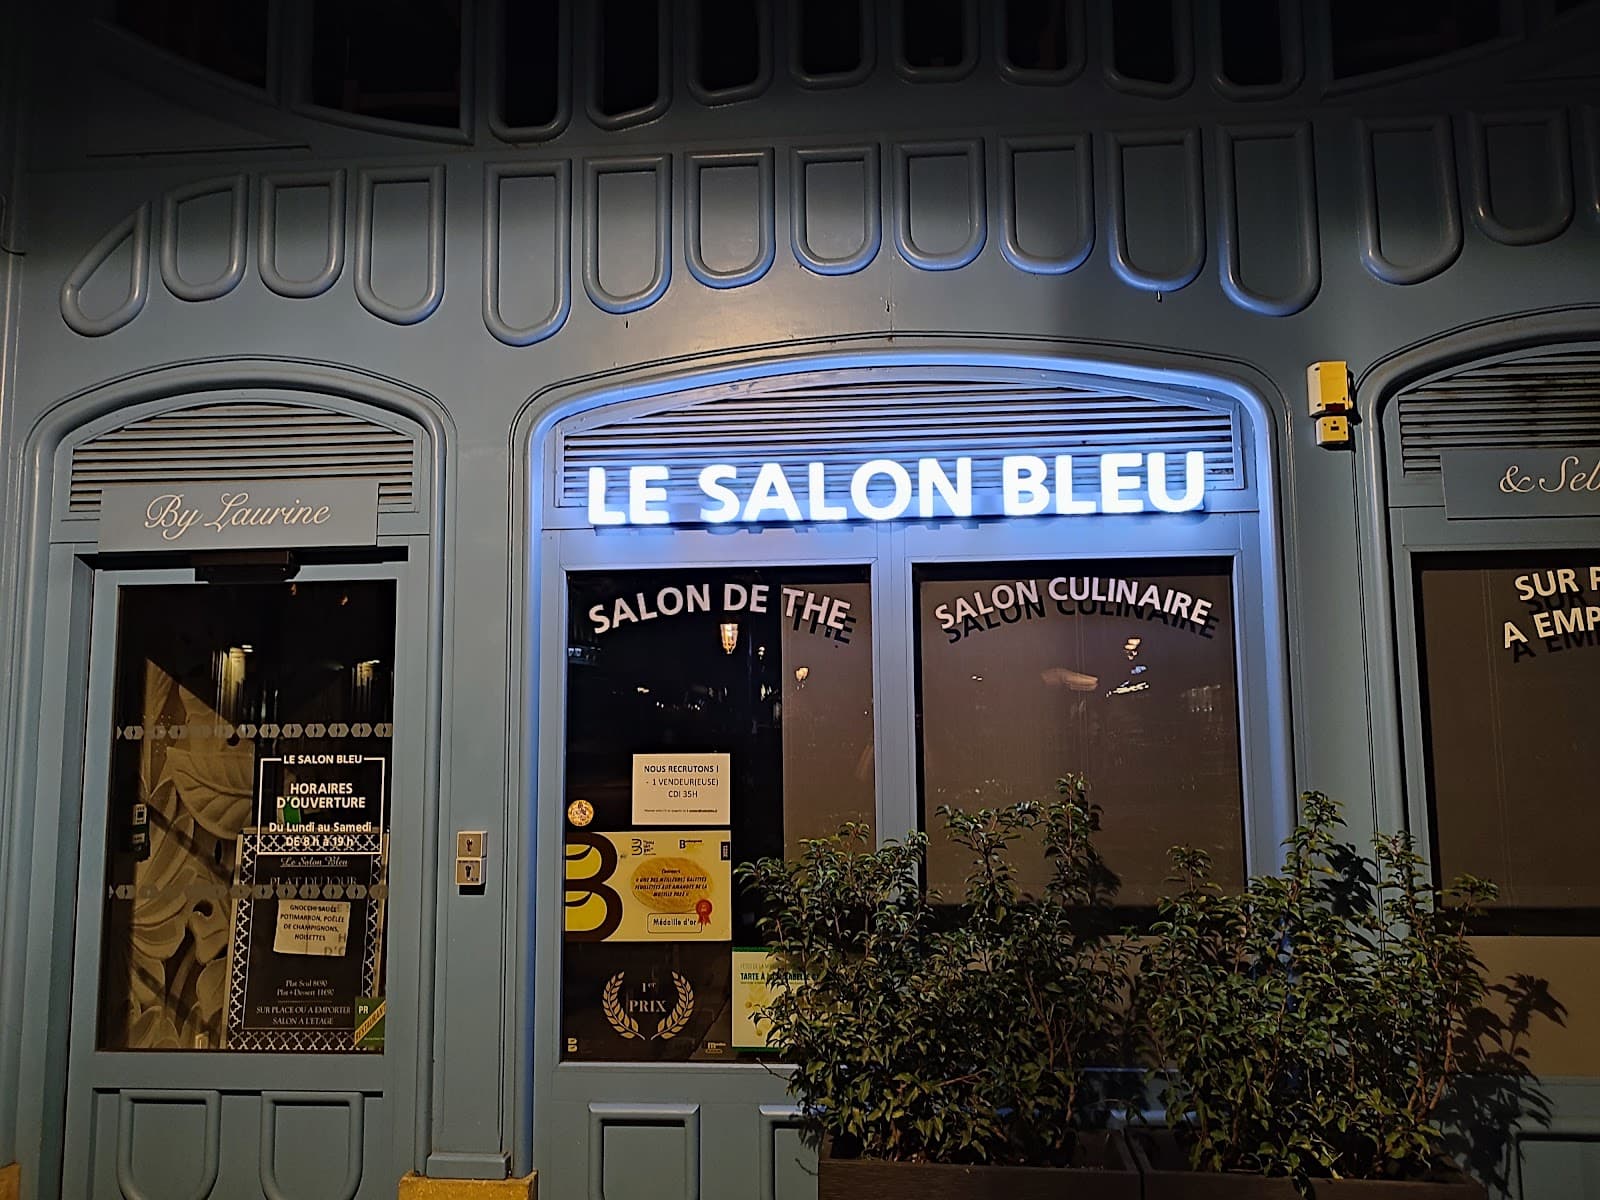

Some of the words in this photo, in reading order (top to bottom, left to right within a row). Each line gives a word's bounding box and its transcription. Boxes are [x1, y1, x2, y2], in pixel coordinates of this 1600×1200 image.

[1499, 465, 1535, 493] &
[588, 465, 670, 525] LE
[697, 457, 972, 523] SALON
[1002, 450, 1206, 516] BLEU
[144, 493, 203, 541] By
[203, 491, 332, 533] Laurine
[1514, 568, 1580, 601] SUR
[588, 583, 711, 634] SALON
[723, 583, 770, 613] DE
[782, 587, 851, 630] THE
[934, 579, 1039, 630] SALON
[1048, 576, 1213, 626] CULINAIRE
[1503, 621, 1529, 649] A
[283, 754, 296, 765] LE
[297, 754, 334, 765] SALON
[336, 754, 363, 764] BLEU
[644, 765, 666, 773] NOUS
[668, 765, 714, 773] RECRUTONS
[652, 778, 656, 786] 1
[658, 778, 719, 787] VENDEUR(EUSE)
[290, 782, 353, 795] HORAIRES
[668, 790, 681, 798] CDI
[682, 790, 698, 798] 35H
[276, 796, 366, 809] D'OUVERTURE
[269, 822, 284, 833] Du
[286, 821, 315, 833] Lundi
[317, 824, 331, 833] au
[333, 821, 372, 833] Samedi
[285, 837, 300, 847] DE
[303, 837, 310, 847] 8
[332, 837, 344, 847] 19
[297, 856, 323, 866] Salon
[653, 918, 682, 926] Médaille
[683, 918, 697, 926] d'or
[294, 934, 326, 942] NOISETTES
[740, 972, 759, 981] TARTE
[256, 1006, 271, 1014] SUR
[271, 1006, 294, 1014] PLACE
[294, 1006, 307, 1014] OU
[628, 1000, 668, 1013] PRIX
[272, 1017, 298, 1025] SALON
